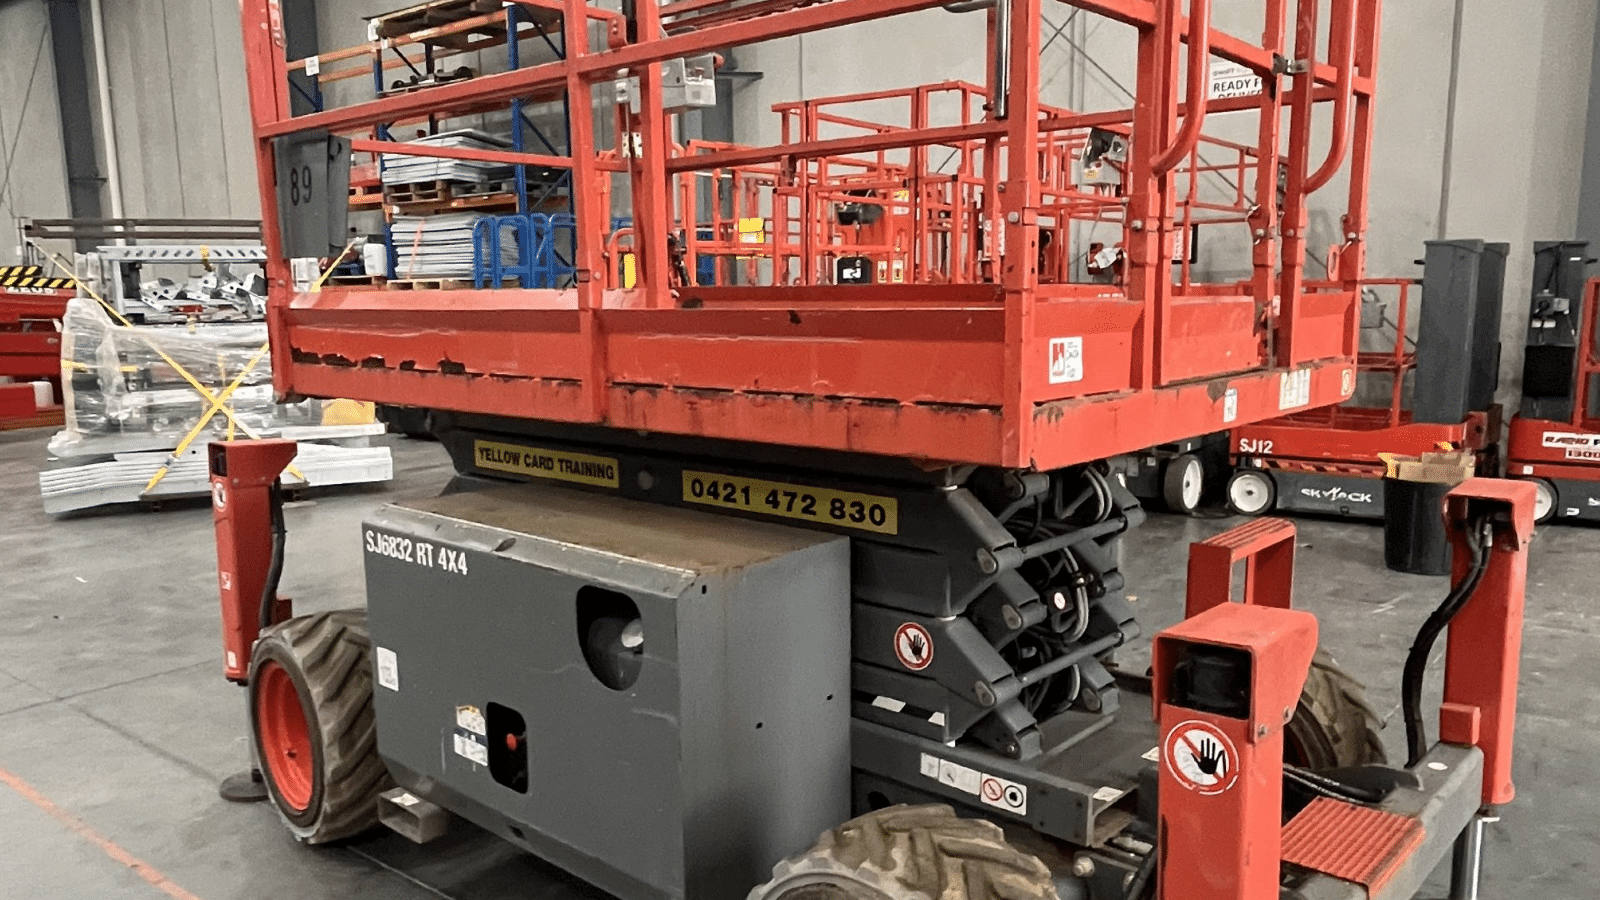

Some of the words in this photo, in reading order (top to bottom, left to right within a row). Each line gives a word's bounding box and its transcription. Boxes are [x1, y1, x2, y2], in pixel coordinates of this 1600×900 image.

[1213, 79, 1251, 92] READY
[290, 165, 312, 206] 89
[479, 447, 521, 466] YELLOW
[523, 453, 555, 471] CARD
[558, 458, 614, 480] TRAINING
[1239, 438, 1273, 454] SJ12
[691, 481, 751, 505] 0421
[765, 489, 817, 516] 472
[829, 498, 886, 526] 830
[365, 530, 413, 563] SJ6832
[416, 542, 434, 568] RT
[438, 547, 468, 575] 4X4
